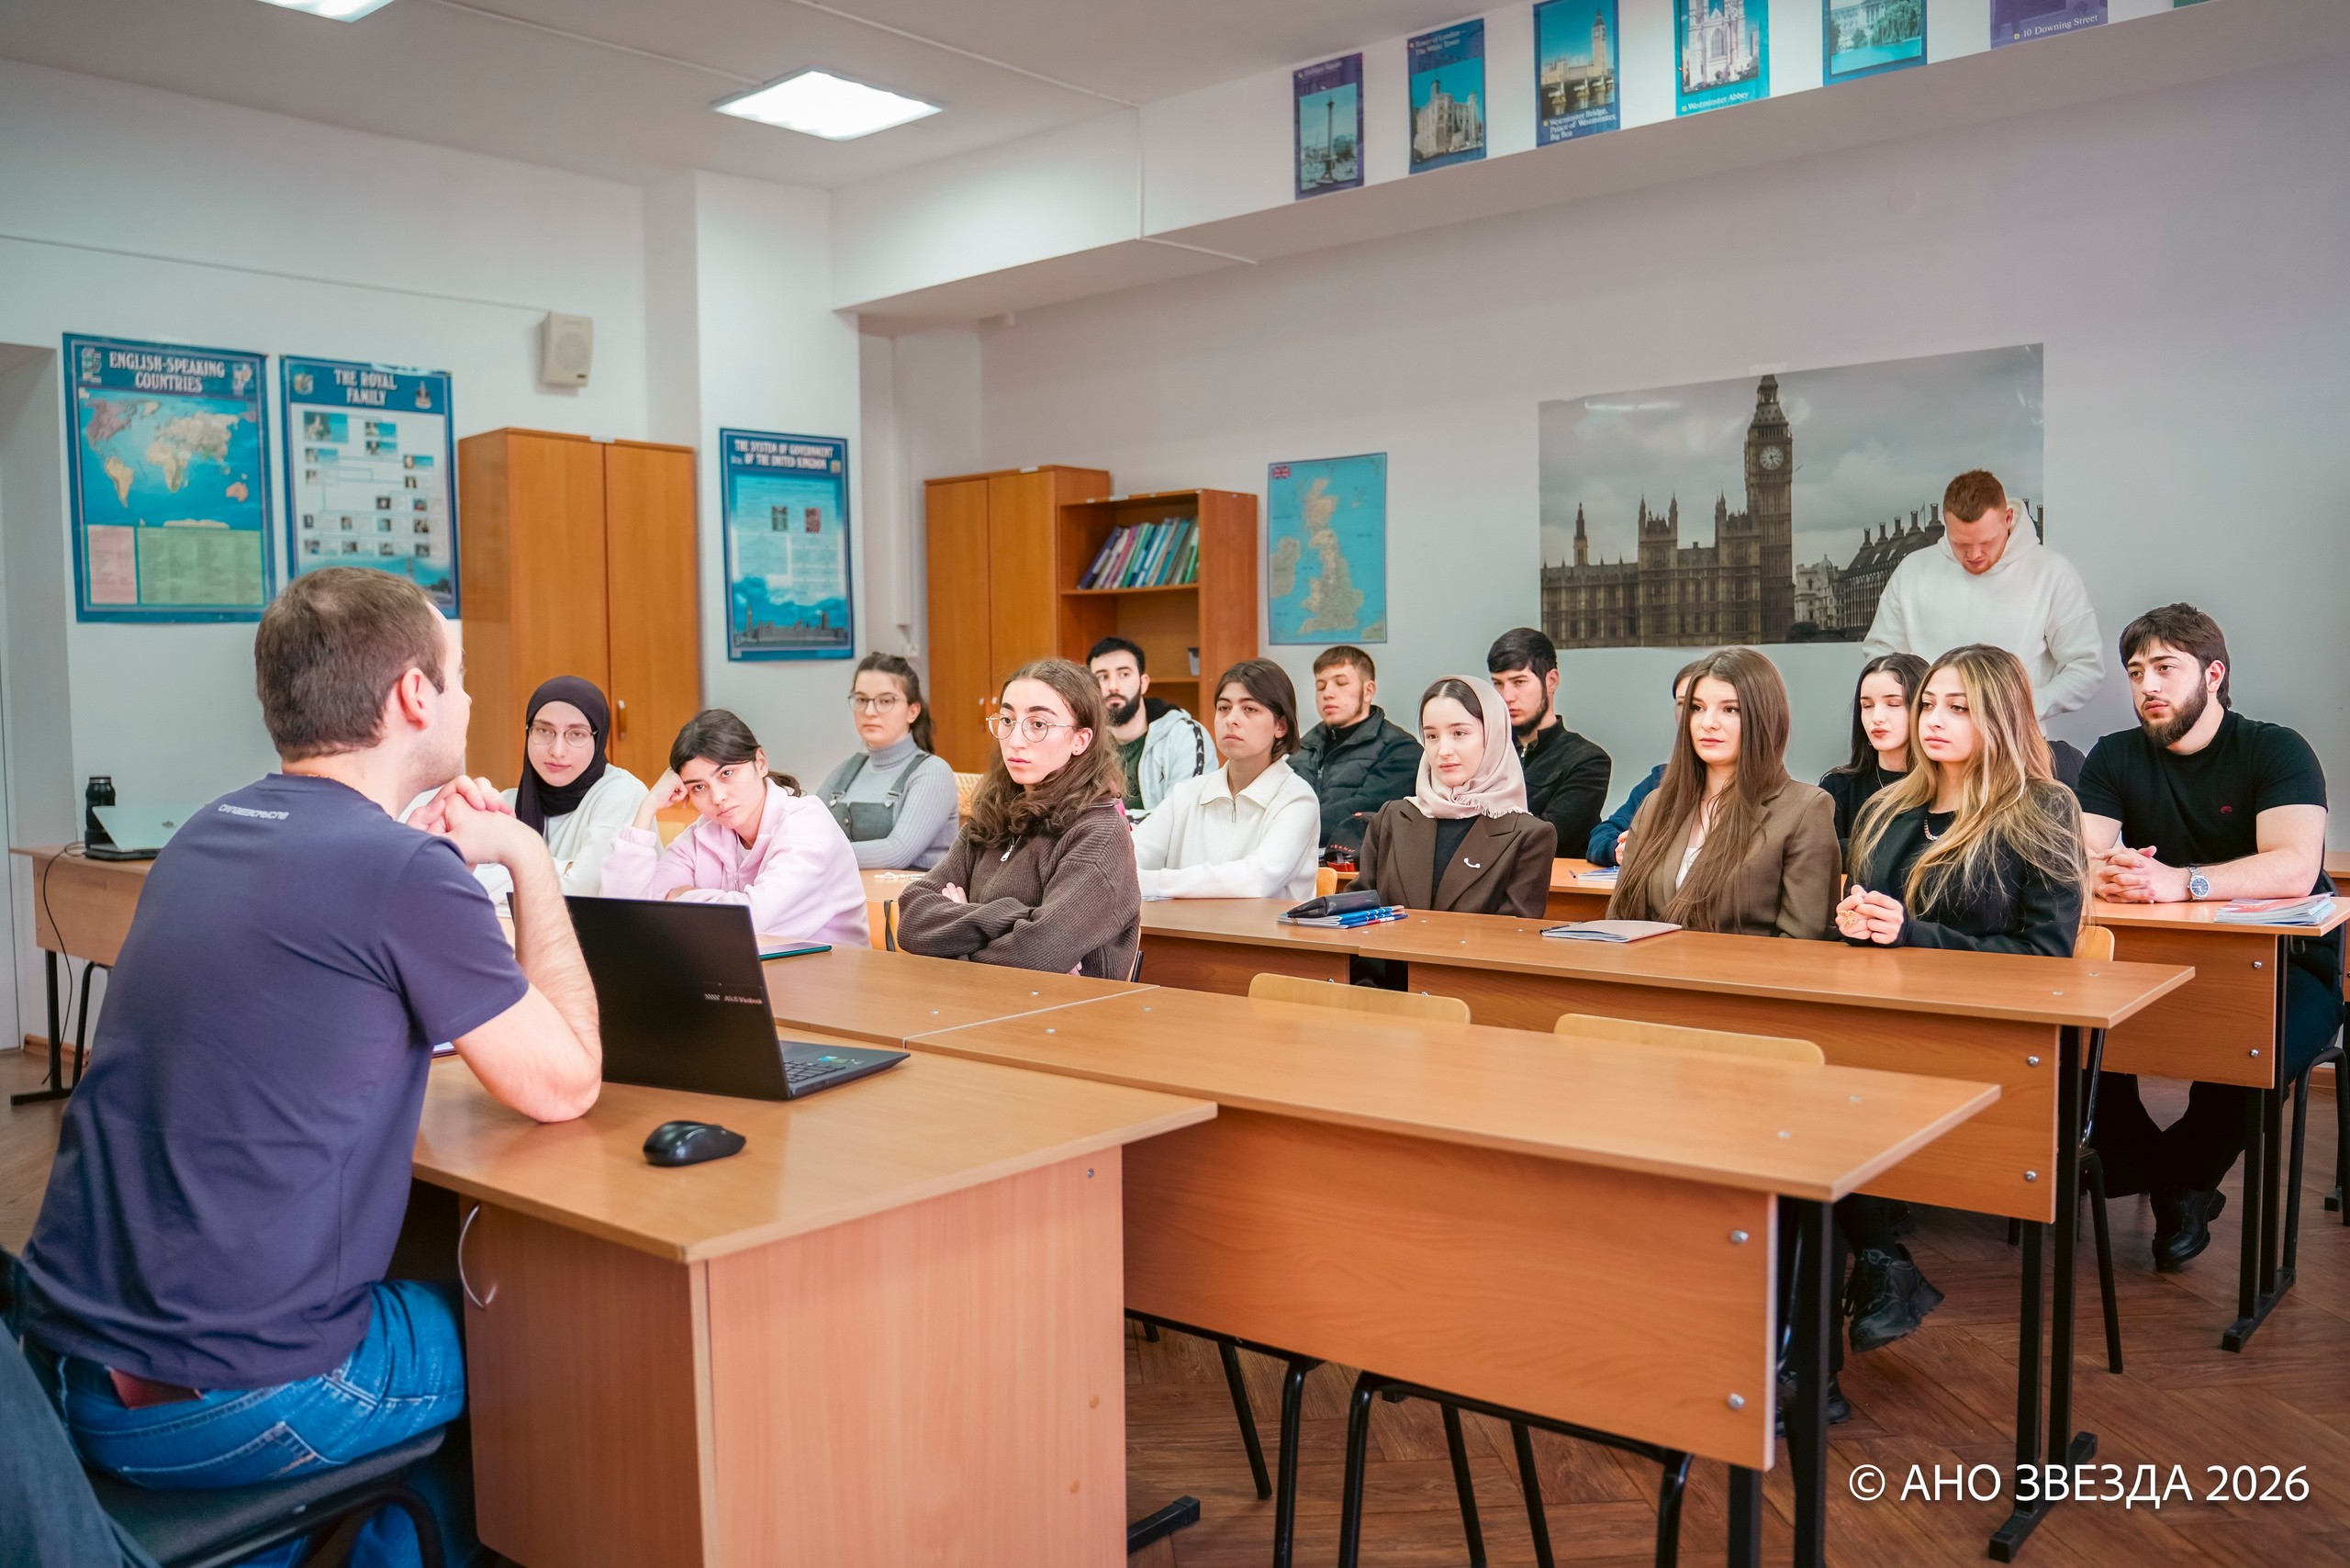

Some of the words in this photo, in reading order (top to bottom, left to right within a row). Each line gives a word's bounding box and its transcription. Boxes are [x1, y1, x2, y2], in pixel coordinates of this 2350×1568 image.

[2034, 21, 2072, 35] Downing
[2073, 15, 2098, 27] Street
[1687, 95, 1728, 109] Westminster
[1728, 92, 1749, 101] Abbey
[1550, 113, 1584, 126] Westminster
[108, 351, 226, 378] ENGLISH-SPEAKING
[135, 371, 203, 393] COUNTRIES
[333, 368, 358, 386] THE
[360, 371, 397, 391] ROYAL
[346, 387, 386, 407] FAMILY
[734, 439, 749, 453] THE
[750, 441, 778, 455] SYSTEM
[778, 442, 789, 455] OF
[789, 444, 834, 458] GOVERNMENT
[744, 454, 755, 465] OF
[756, 454, 771, 466] THE
